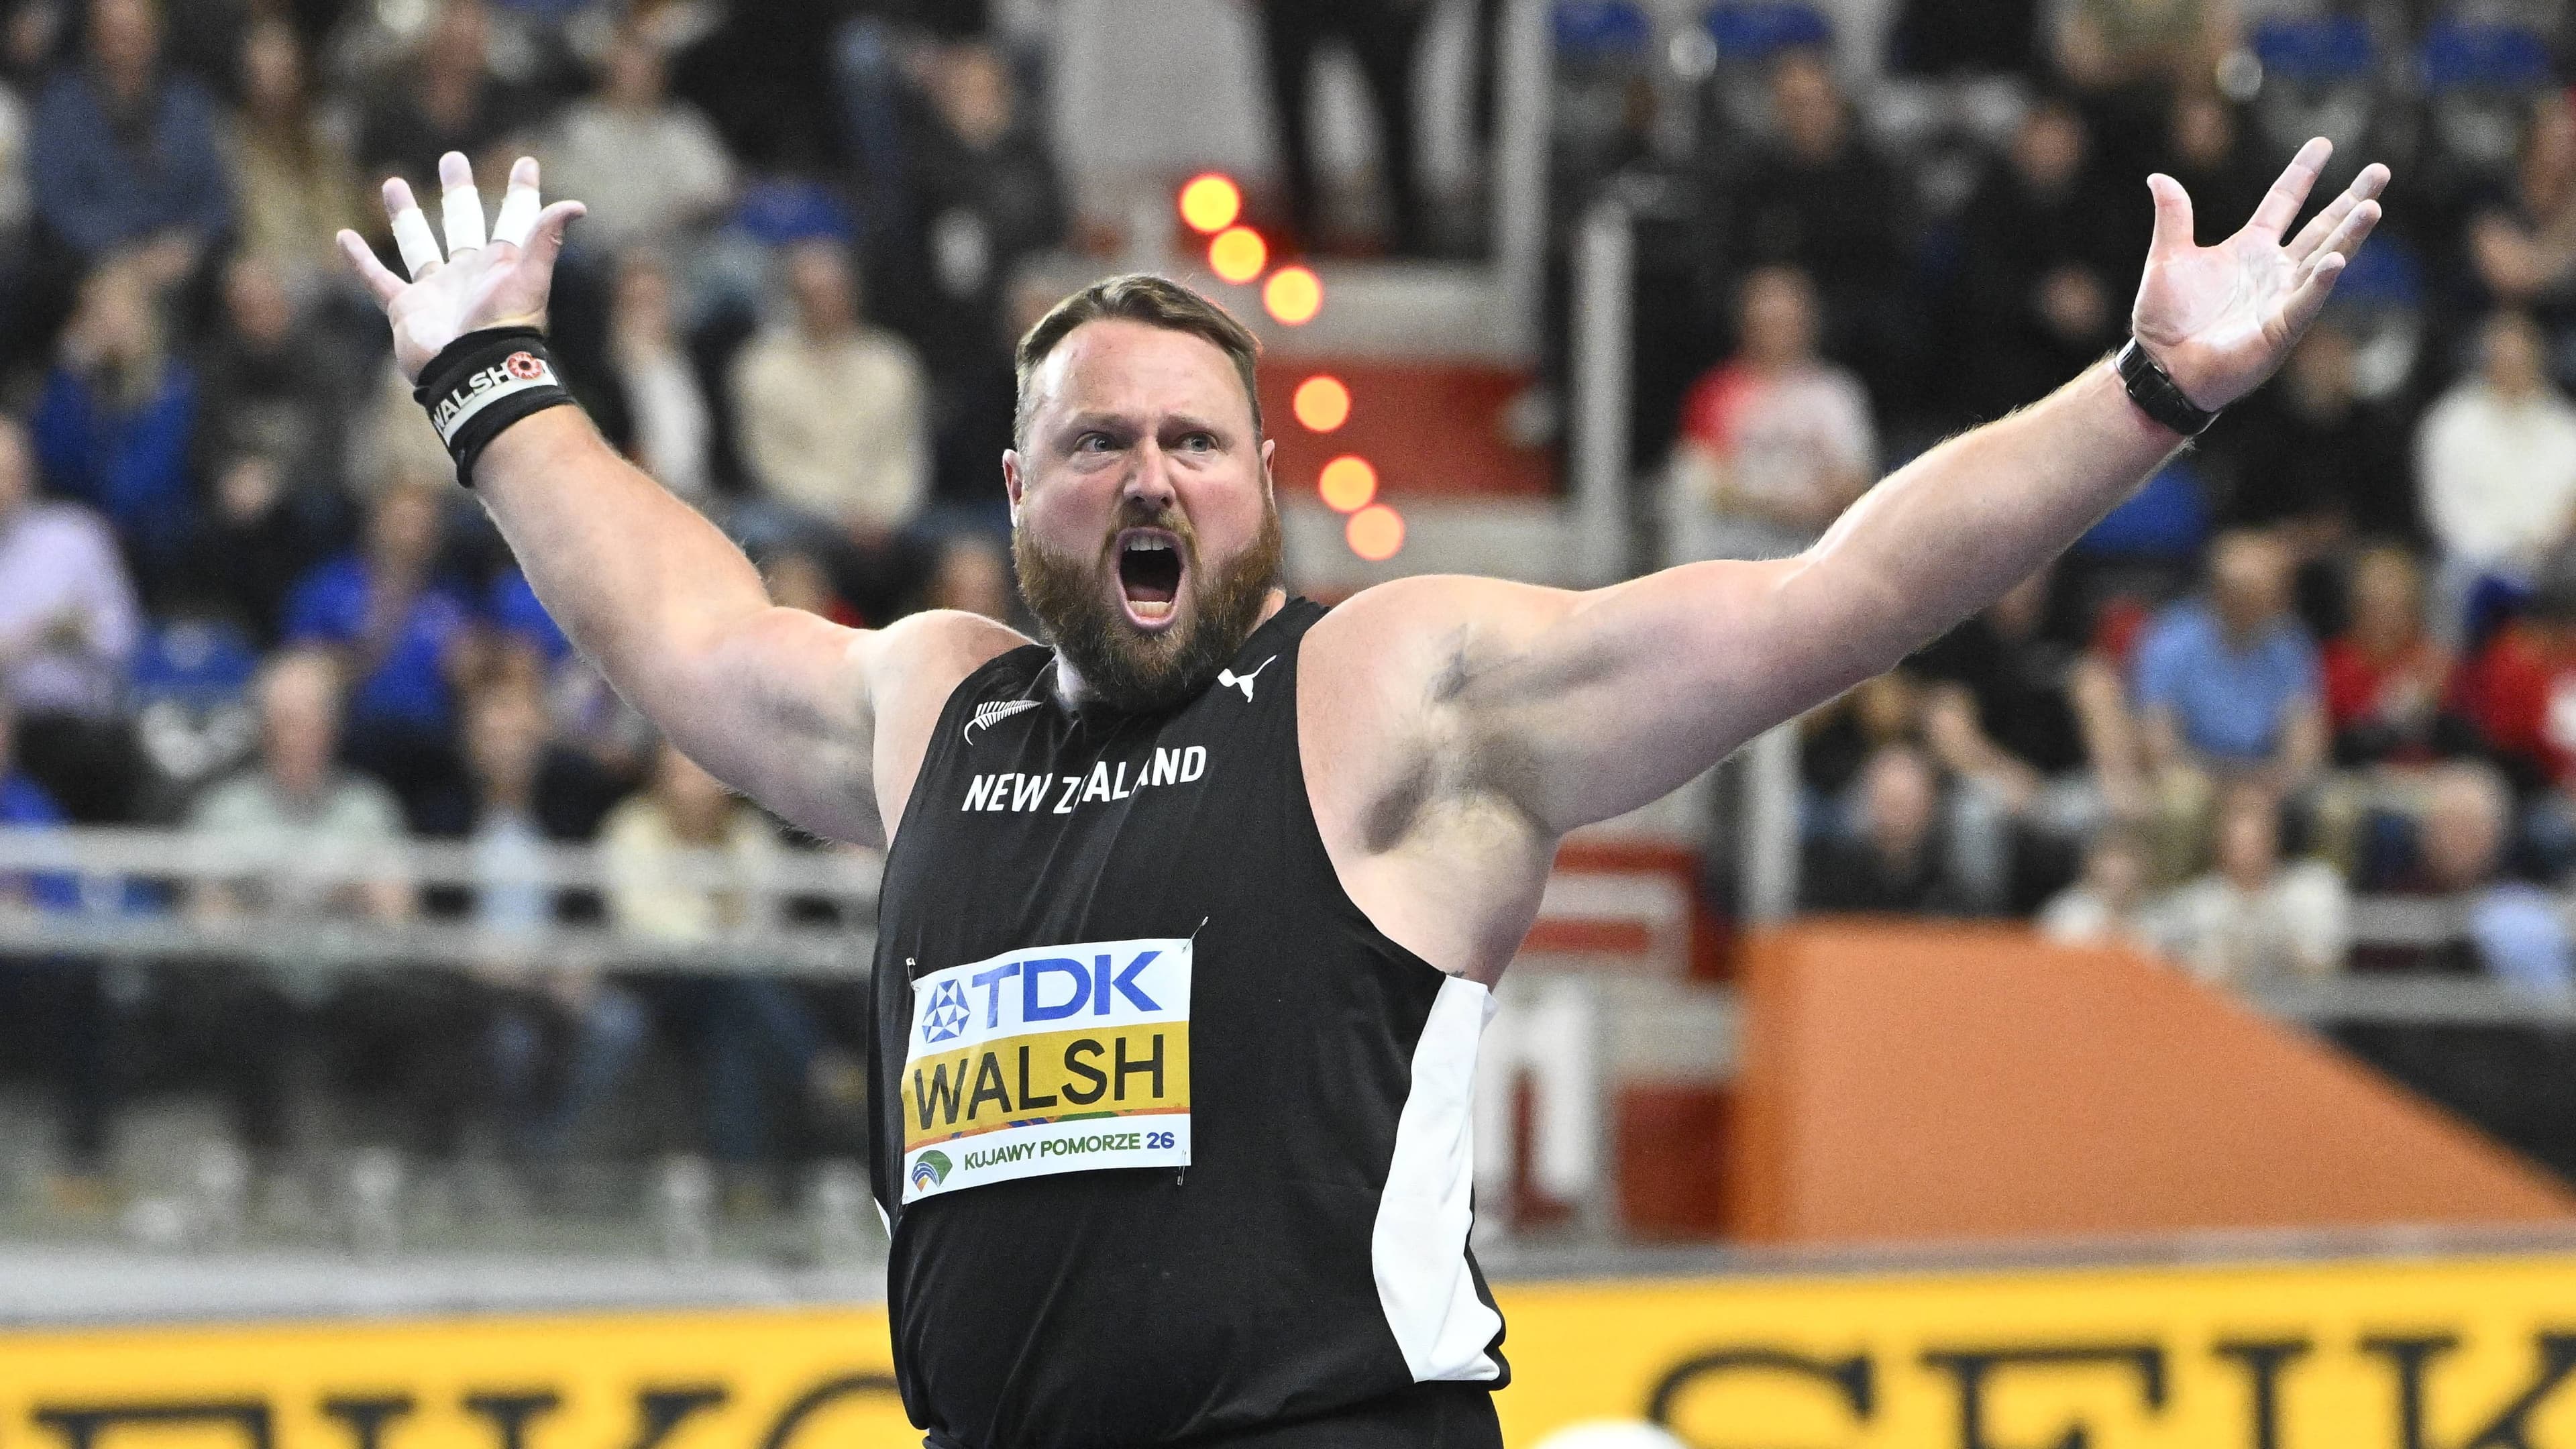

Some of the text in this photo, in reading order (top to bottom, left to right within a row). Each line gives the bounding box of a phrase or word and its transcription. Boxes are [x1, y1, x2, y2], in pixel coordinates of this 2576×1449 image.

[961, 745, 1207, 814] NEW ZALAND
[971, 951, 1163, 1029] TDK
[914, 1034, 1164, 1130] WALSH
[965, 1132, 1175, 1170] KUJAWY POMORZE 26
